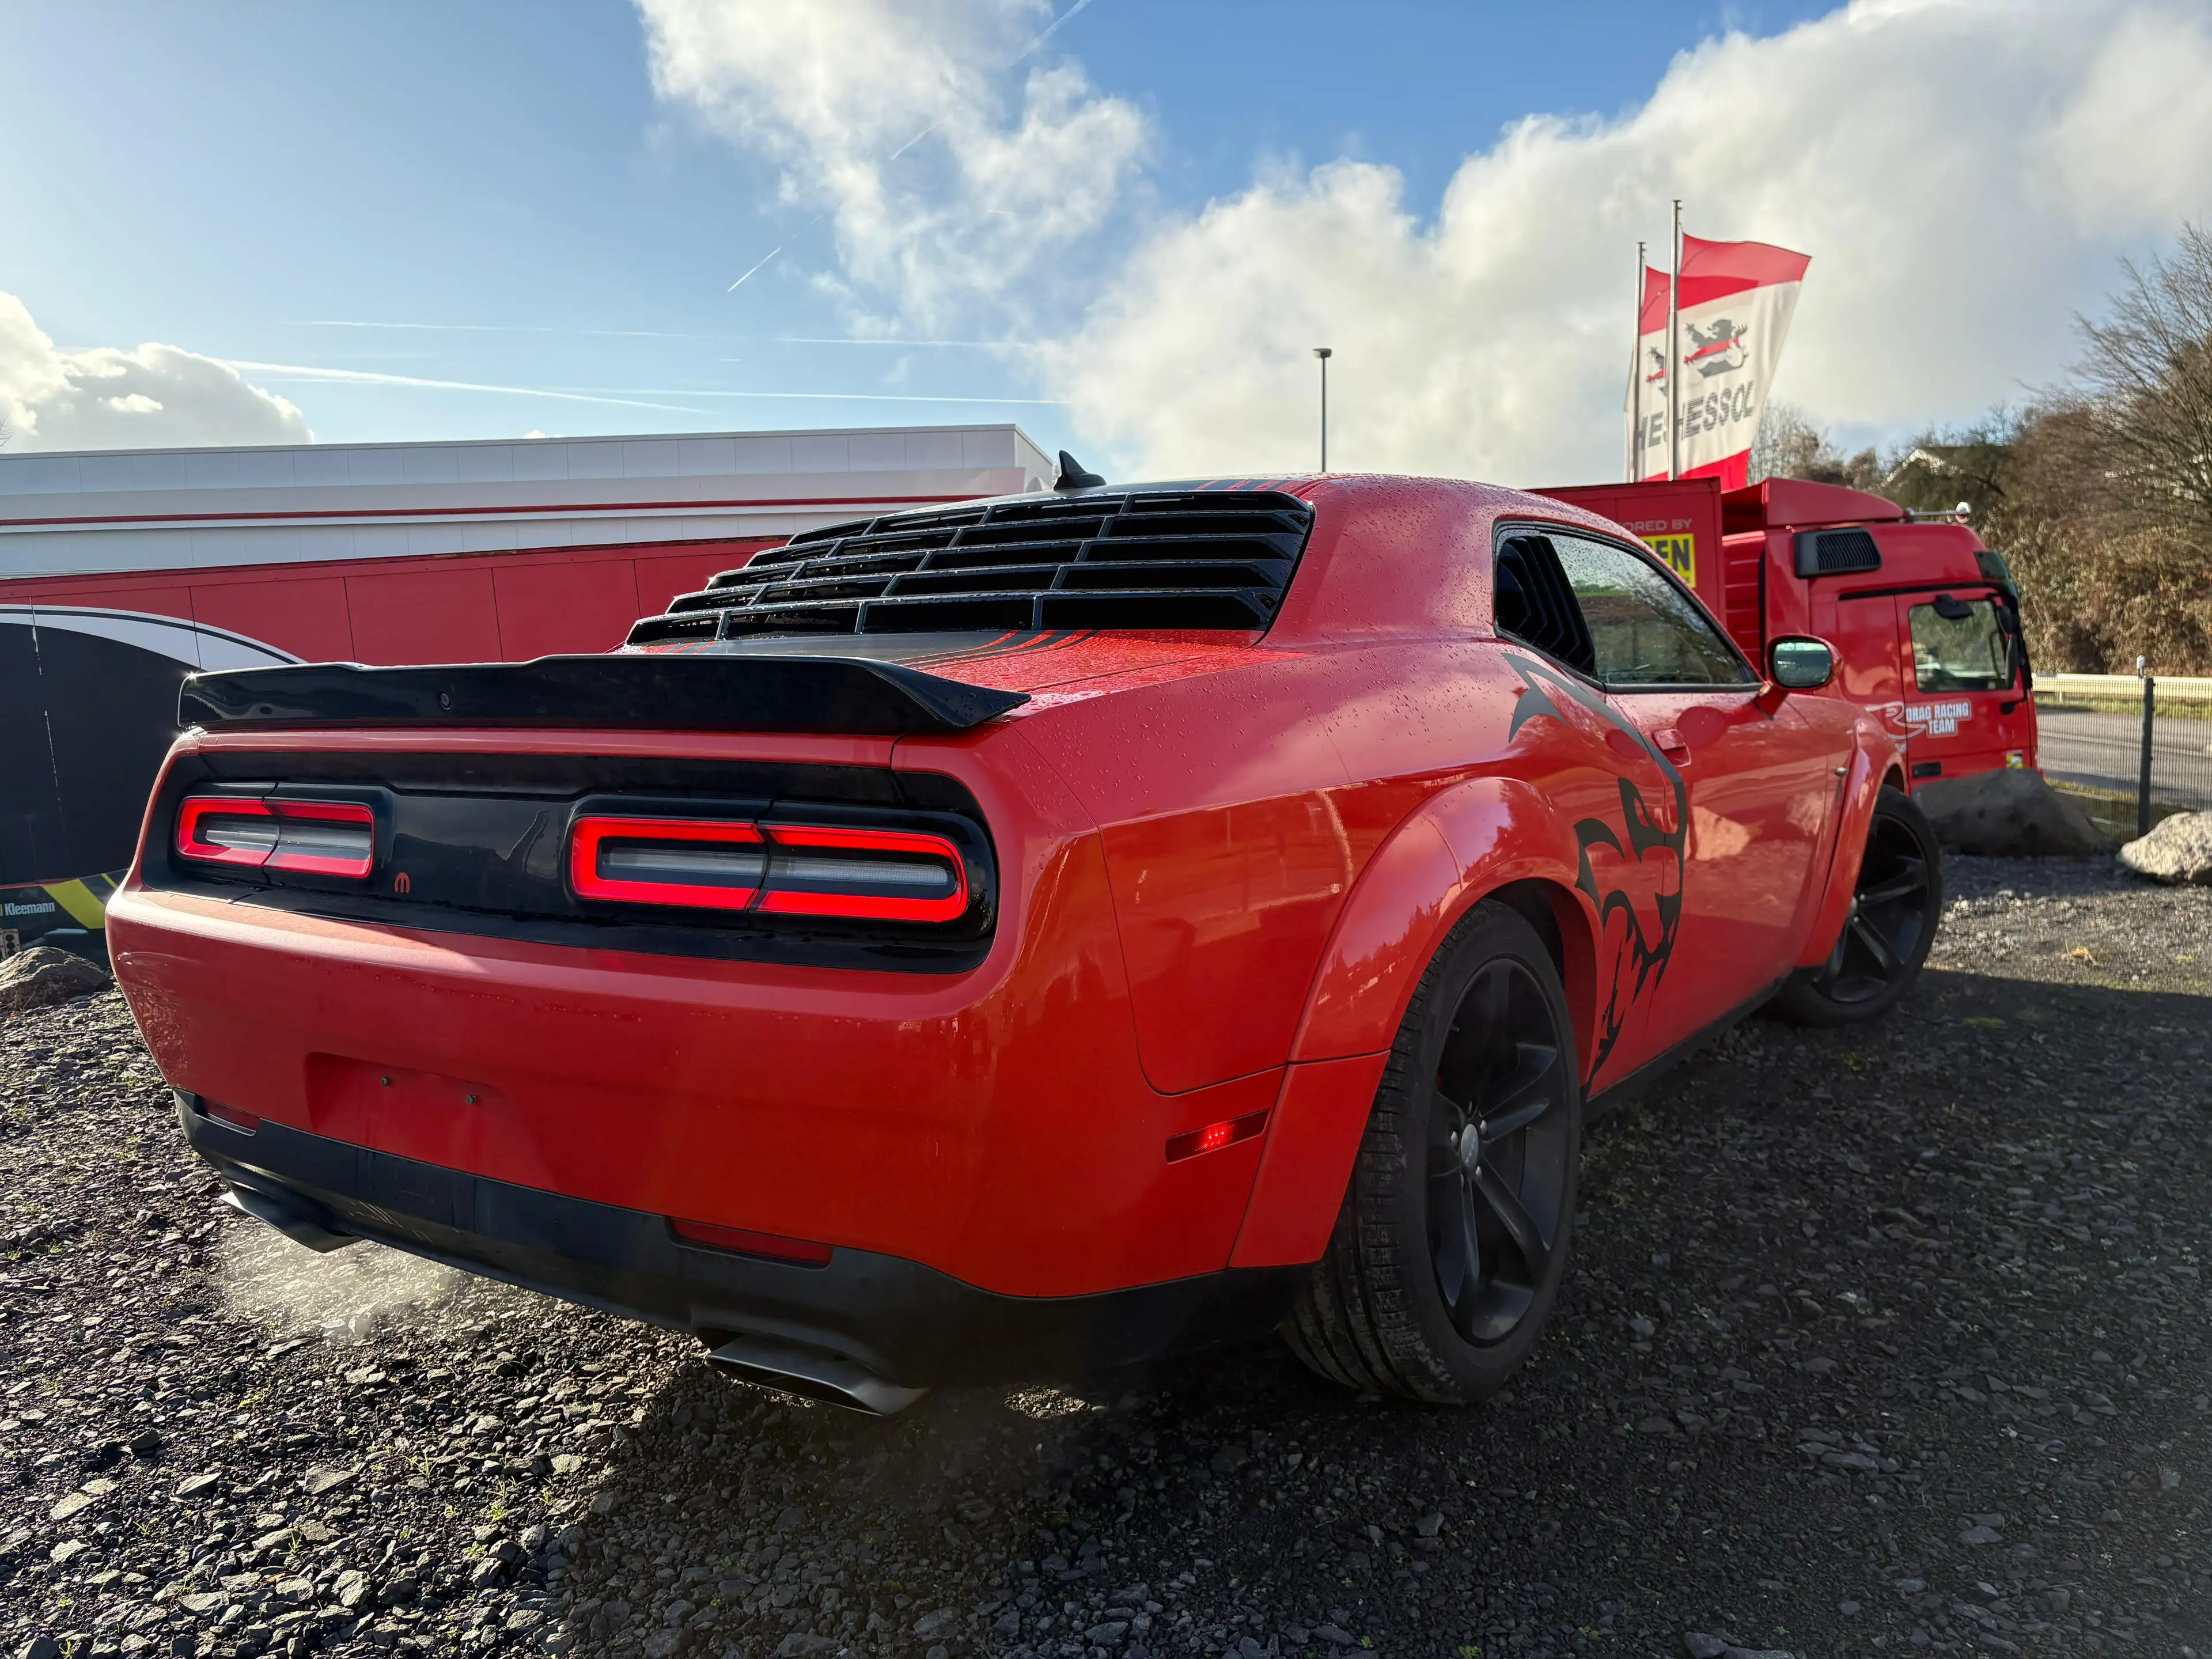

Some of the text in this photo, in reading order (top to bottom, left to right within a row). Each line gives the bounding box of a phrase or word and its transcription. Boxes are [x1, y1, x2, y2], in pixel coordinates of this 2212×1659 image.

[1619, 518, 1692, 532] ORED BY
[1644, 539, 1690, 572] EN
[1906, 702, 1969, 722] DRAG RACING
[1929, 719, 1955, 734] TEAM
[5, 902, 55, 916] Kleemann
